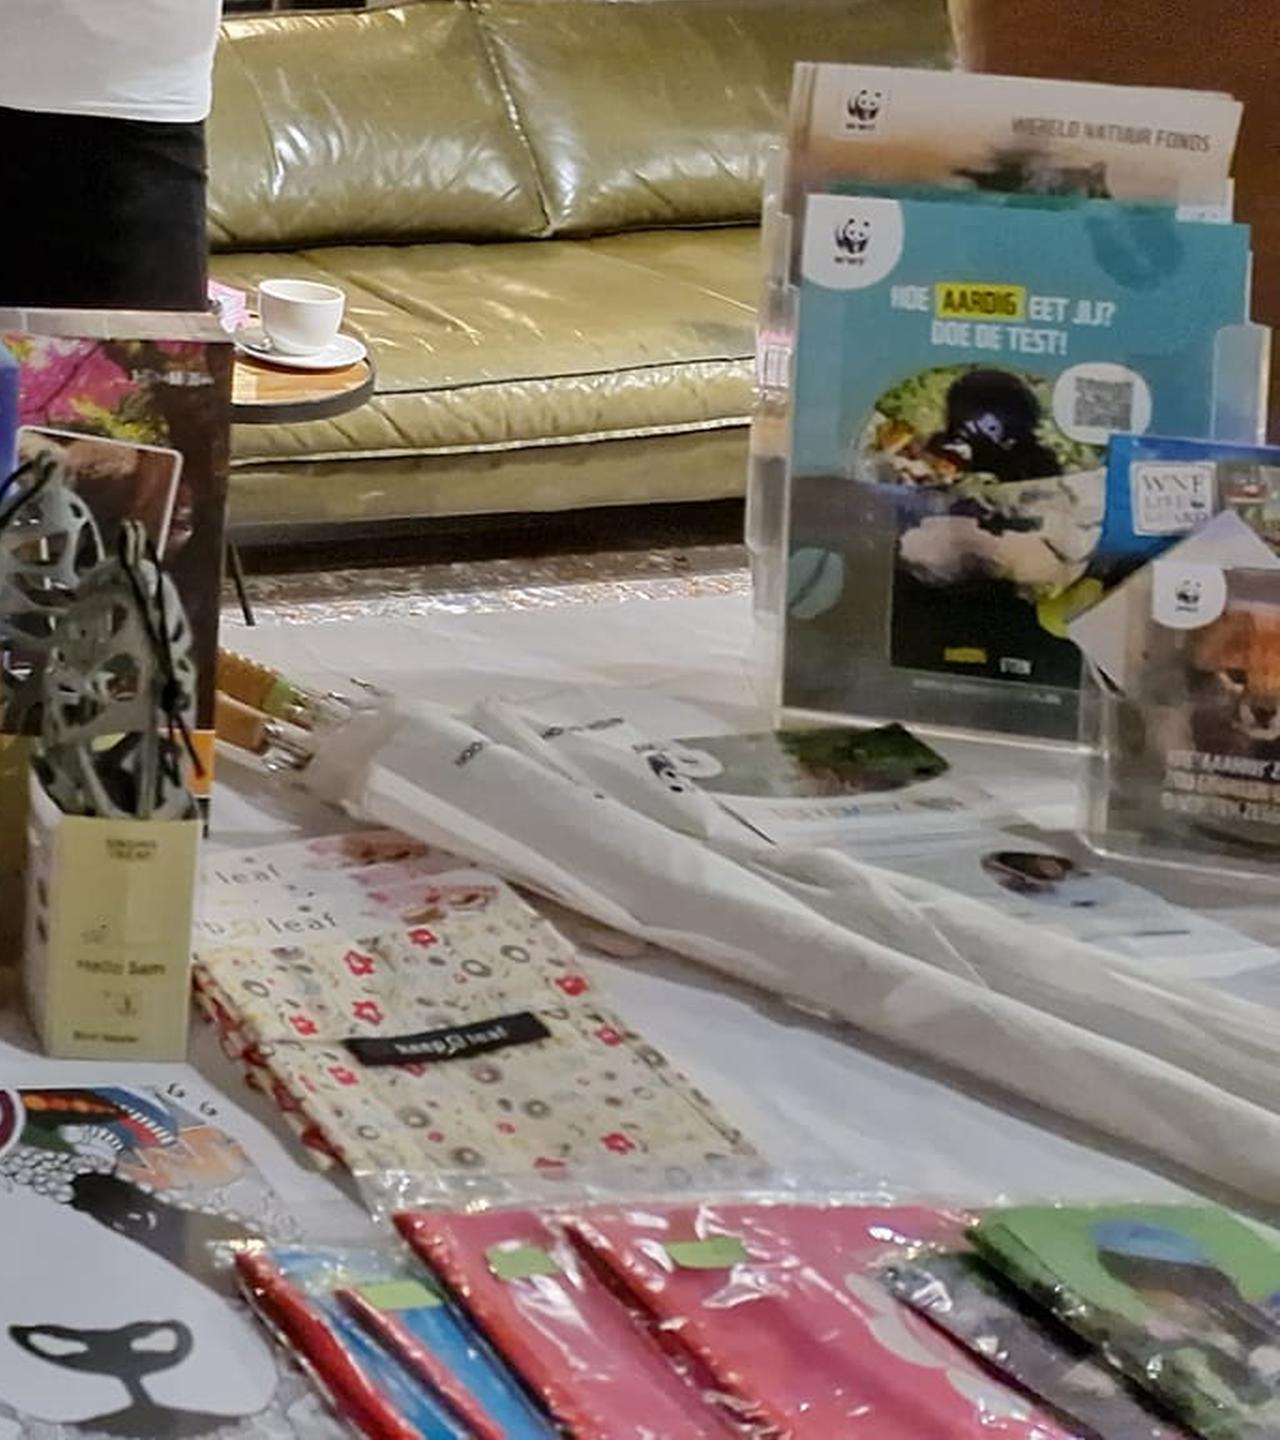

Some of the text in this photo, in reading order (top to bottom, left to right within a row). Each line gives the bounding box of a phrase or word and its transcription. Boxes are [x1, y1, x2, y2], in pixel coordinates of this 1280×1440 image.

[1011, 117, 1211, 153] WERELD NATUUR FONDS
[890, 284, 930, 311] HOE
[942, 289, 1018, 316] AARDIG
[1029, 295, 1070, 323] EET
[930, 319, 1068, 356] DOE DE TEST!
[266, 912, 337, 934] leaf
